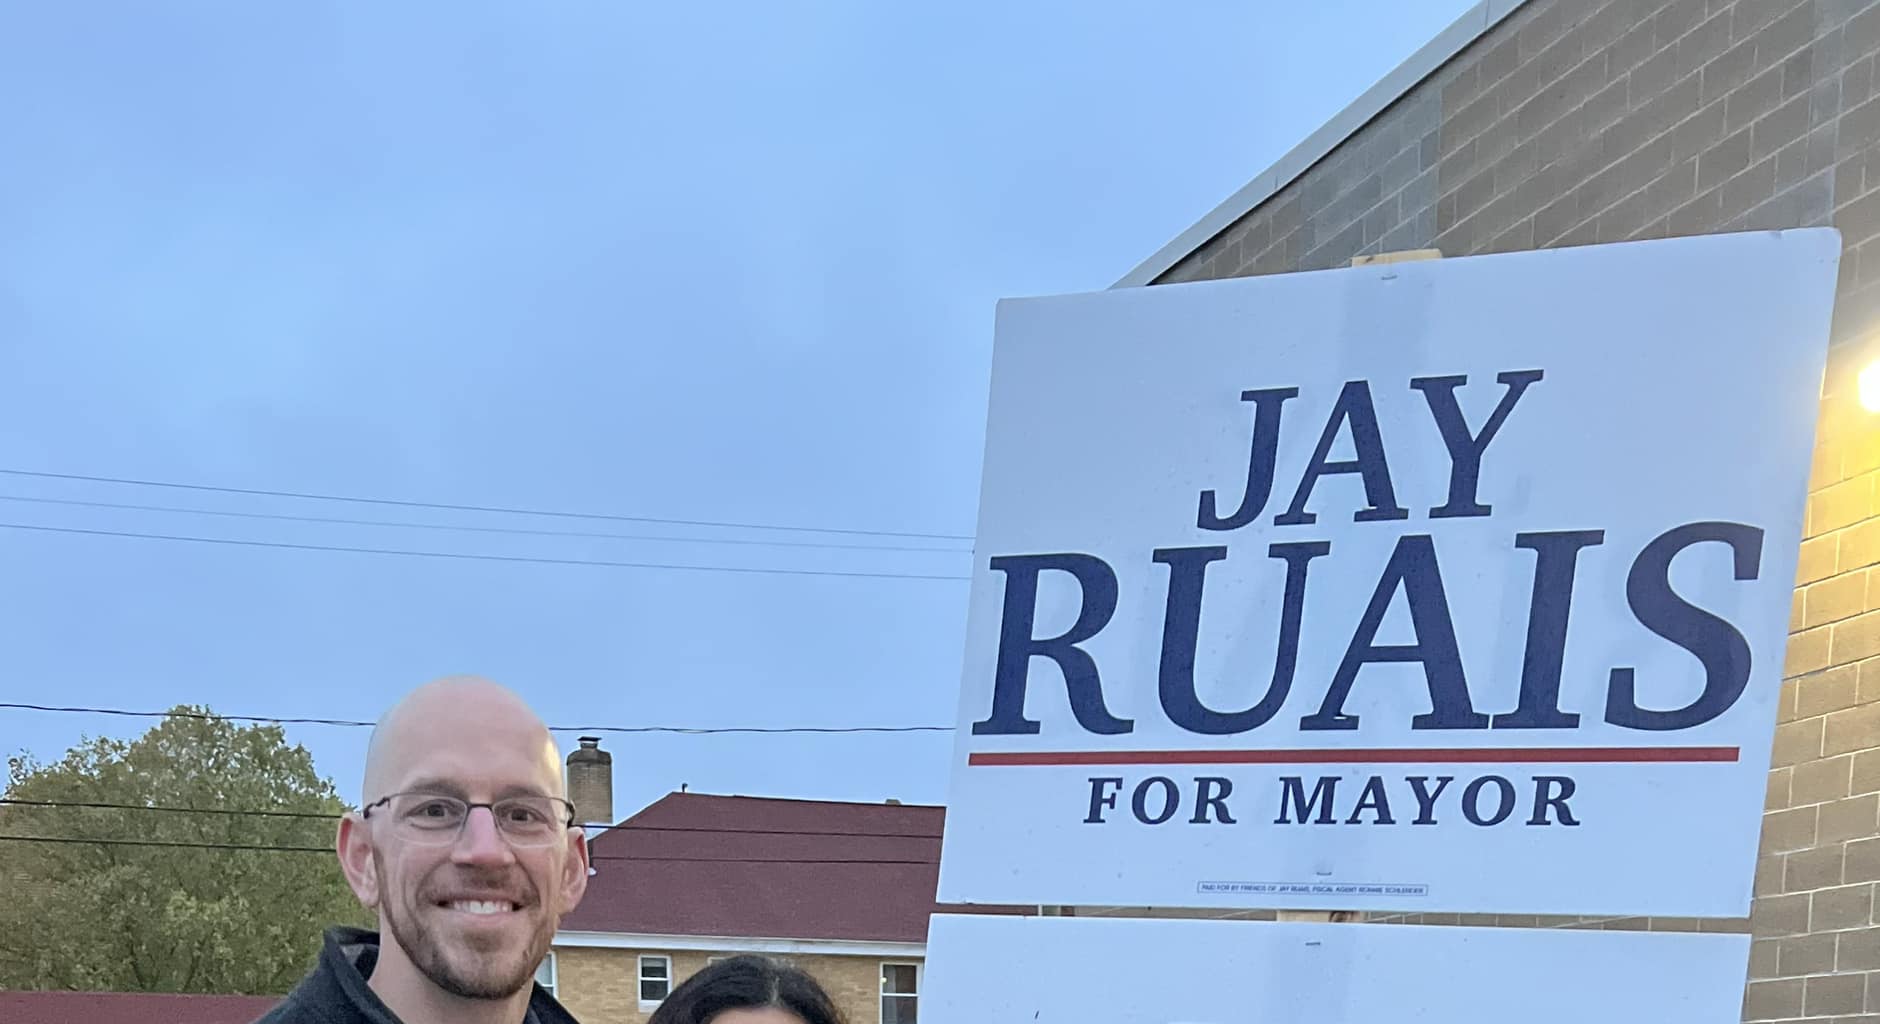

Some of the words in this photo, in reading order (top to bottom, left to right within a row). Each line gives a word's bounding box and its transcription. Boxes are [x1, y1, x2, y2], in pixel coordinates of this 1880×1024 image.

[1197, 369, 1545, 531] JAY
[971, 521, 1765, 736] RUAIS
[1083, 776, 1237, 825] FOR
[1273, 775, 1581, 827] MAYOR
[1241, 884, 1266, 892] FRIENDS
